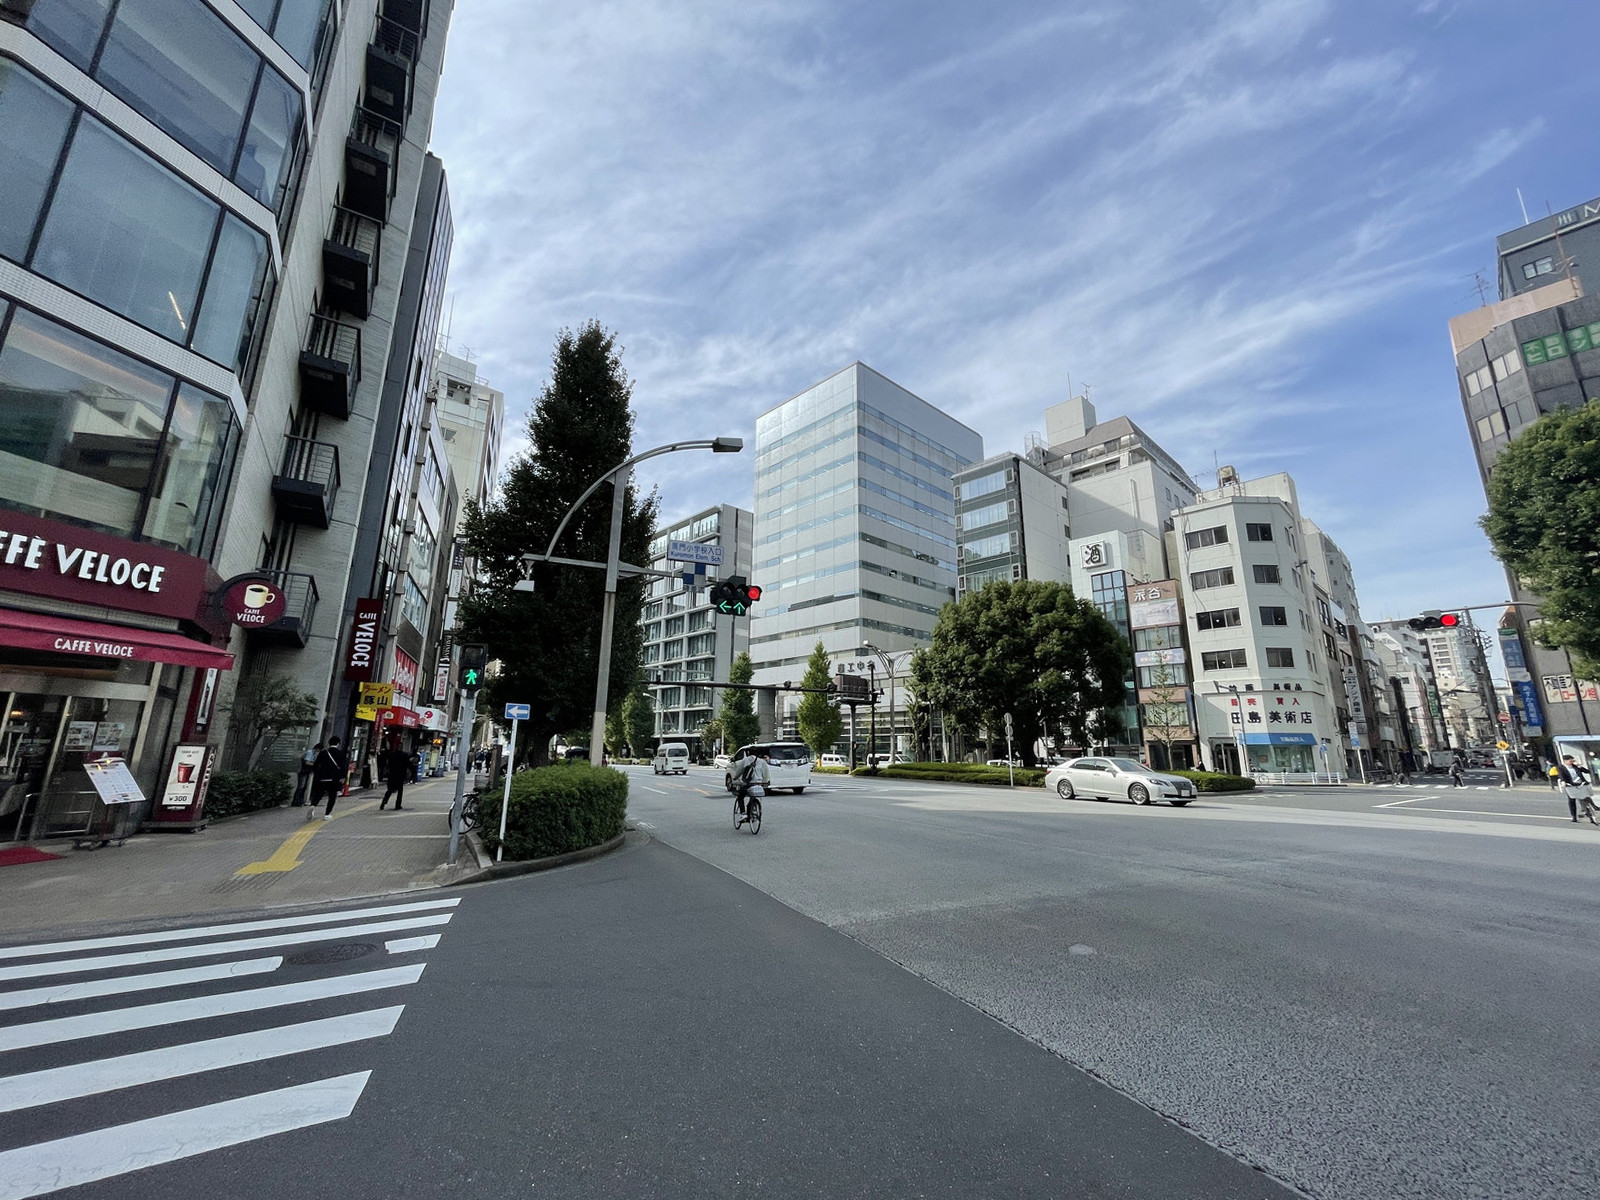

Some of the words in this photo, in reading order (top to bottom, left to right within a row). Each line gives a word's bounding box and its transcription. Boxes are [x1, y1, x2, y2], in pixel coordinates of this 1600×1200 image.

[671, 551, 694, 560] Kuromon
[1084, 544, 1102, 565] 酒
[56, 543, 165, 593] VELOCE
[236, 613, 266, 624] VELOCE
[93, 642, 133, 657] VELOCE
[351, 622, 376, 667] VELOCE
[363, 685, 391, 694] ラーメン
